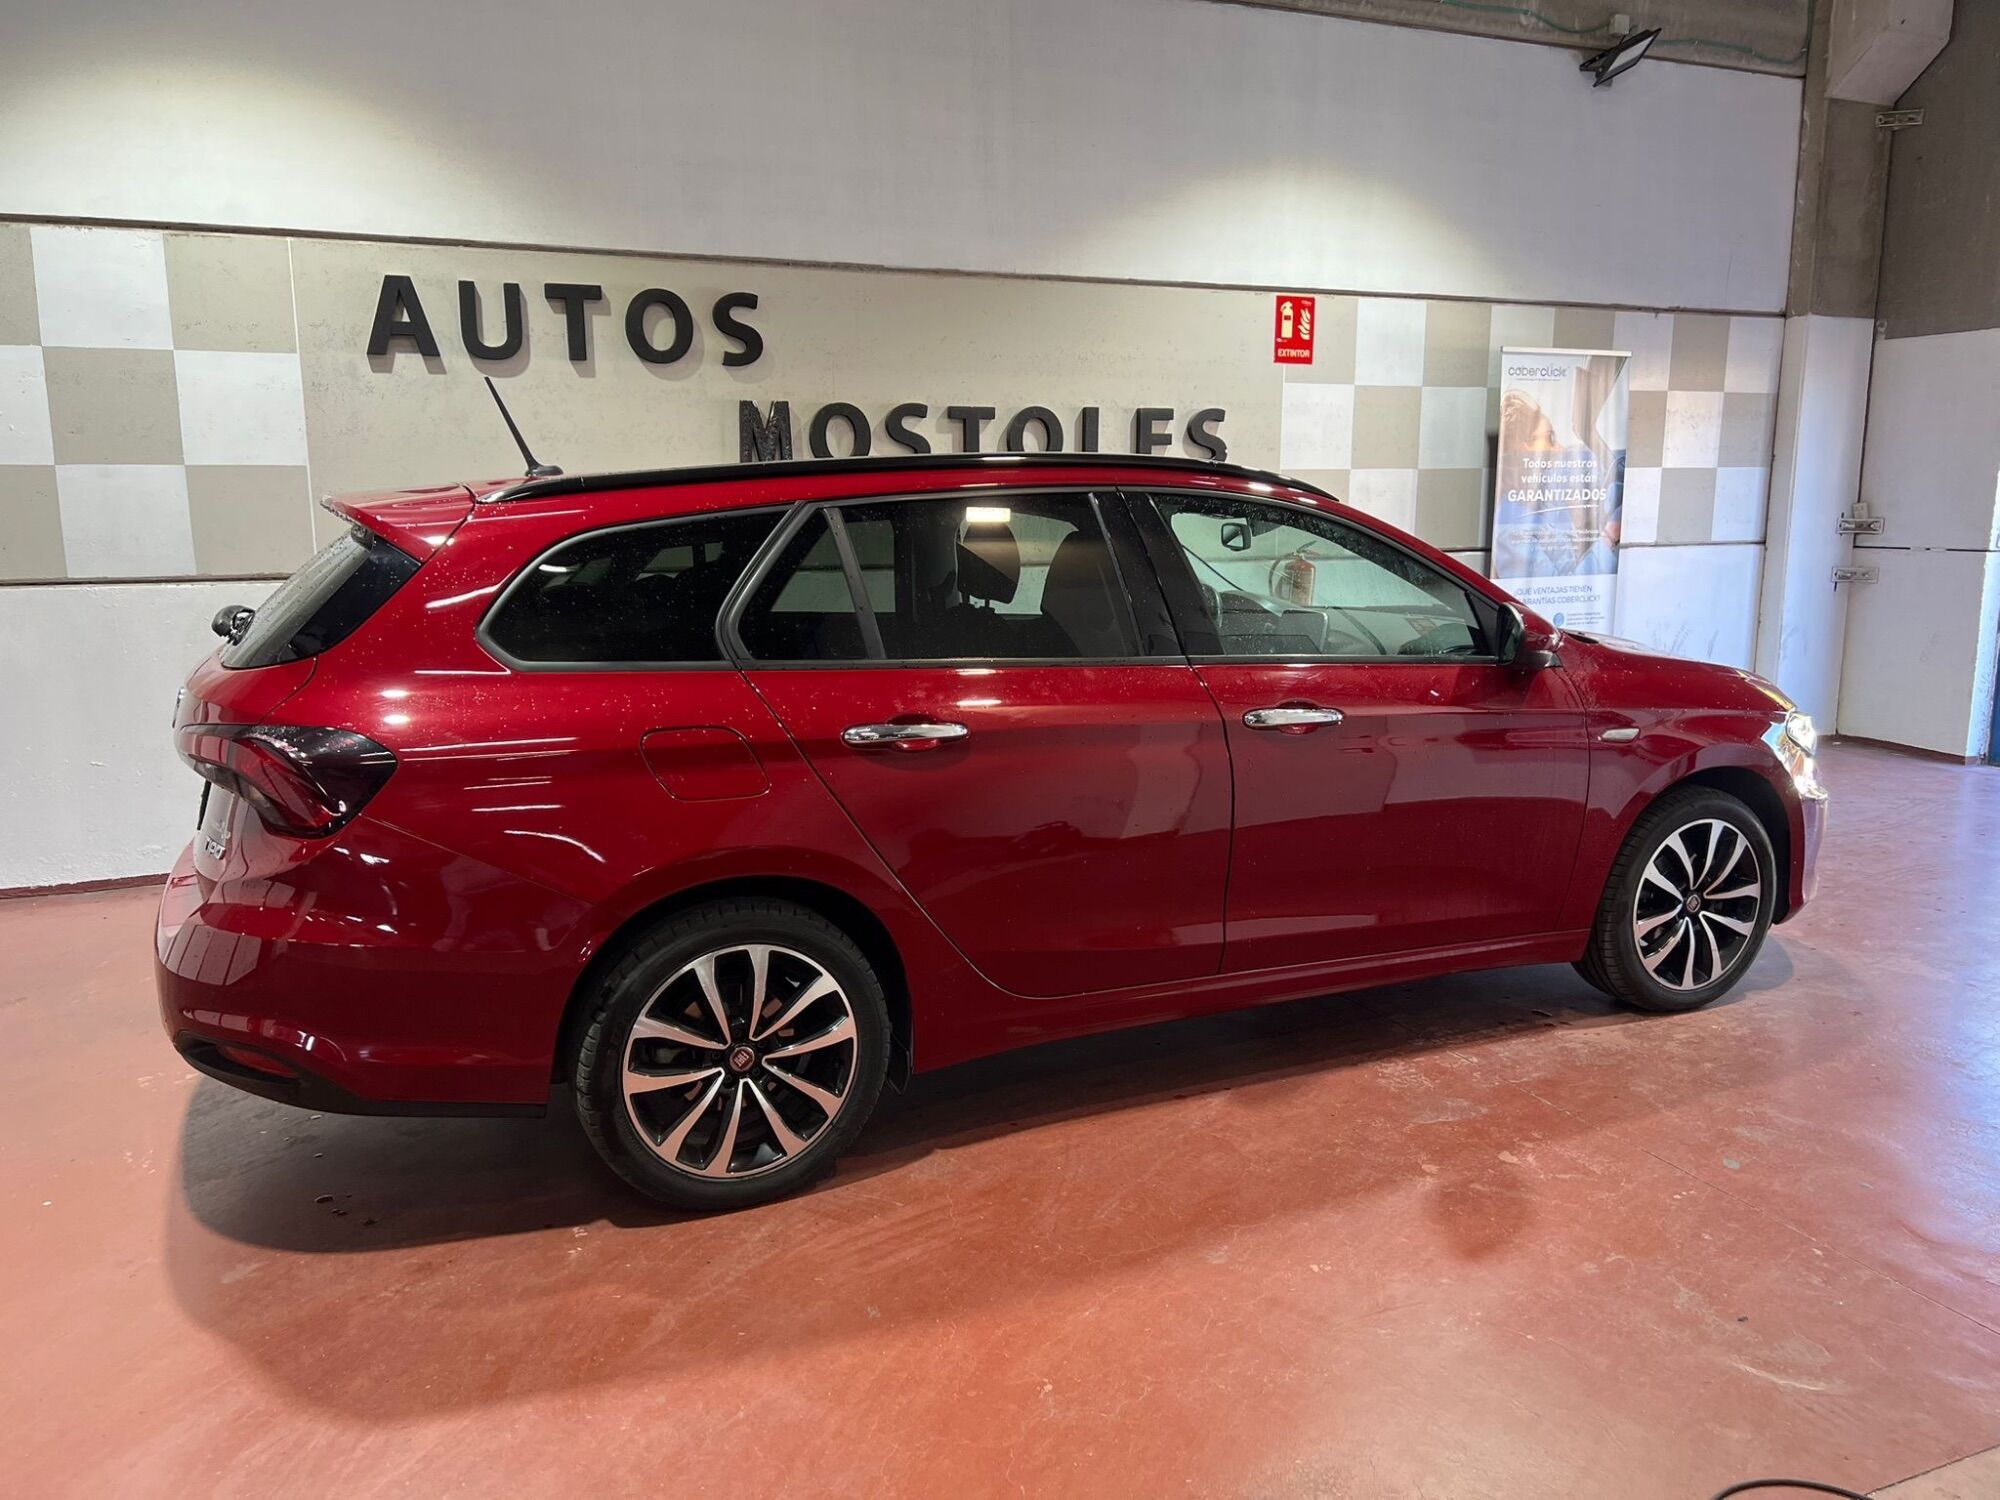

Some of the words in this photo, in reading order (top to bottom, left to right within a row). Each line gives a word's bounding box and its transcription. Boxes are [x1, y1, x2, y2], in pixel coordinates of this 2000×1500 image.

[367, 275, 764, 367] AUTOS
[1277, 348, 1310, 358] EXTINTOR
[1522, 458, 1553, 469] Todos
[1554, 459, 1597, 468] nuestros
[1521, 472, 1568, 483] vehículos
[1569, 472, 1597, 483] están
[1507, 488, 1607, 502] GARANTIZADOS
[1533, 586, 1568, 595] VENTAJAS
[1568, 584, 1593, 593] TIENEN
